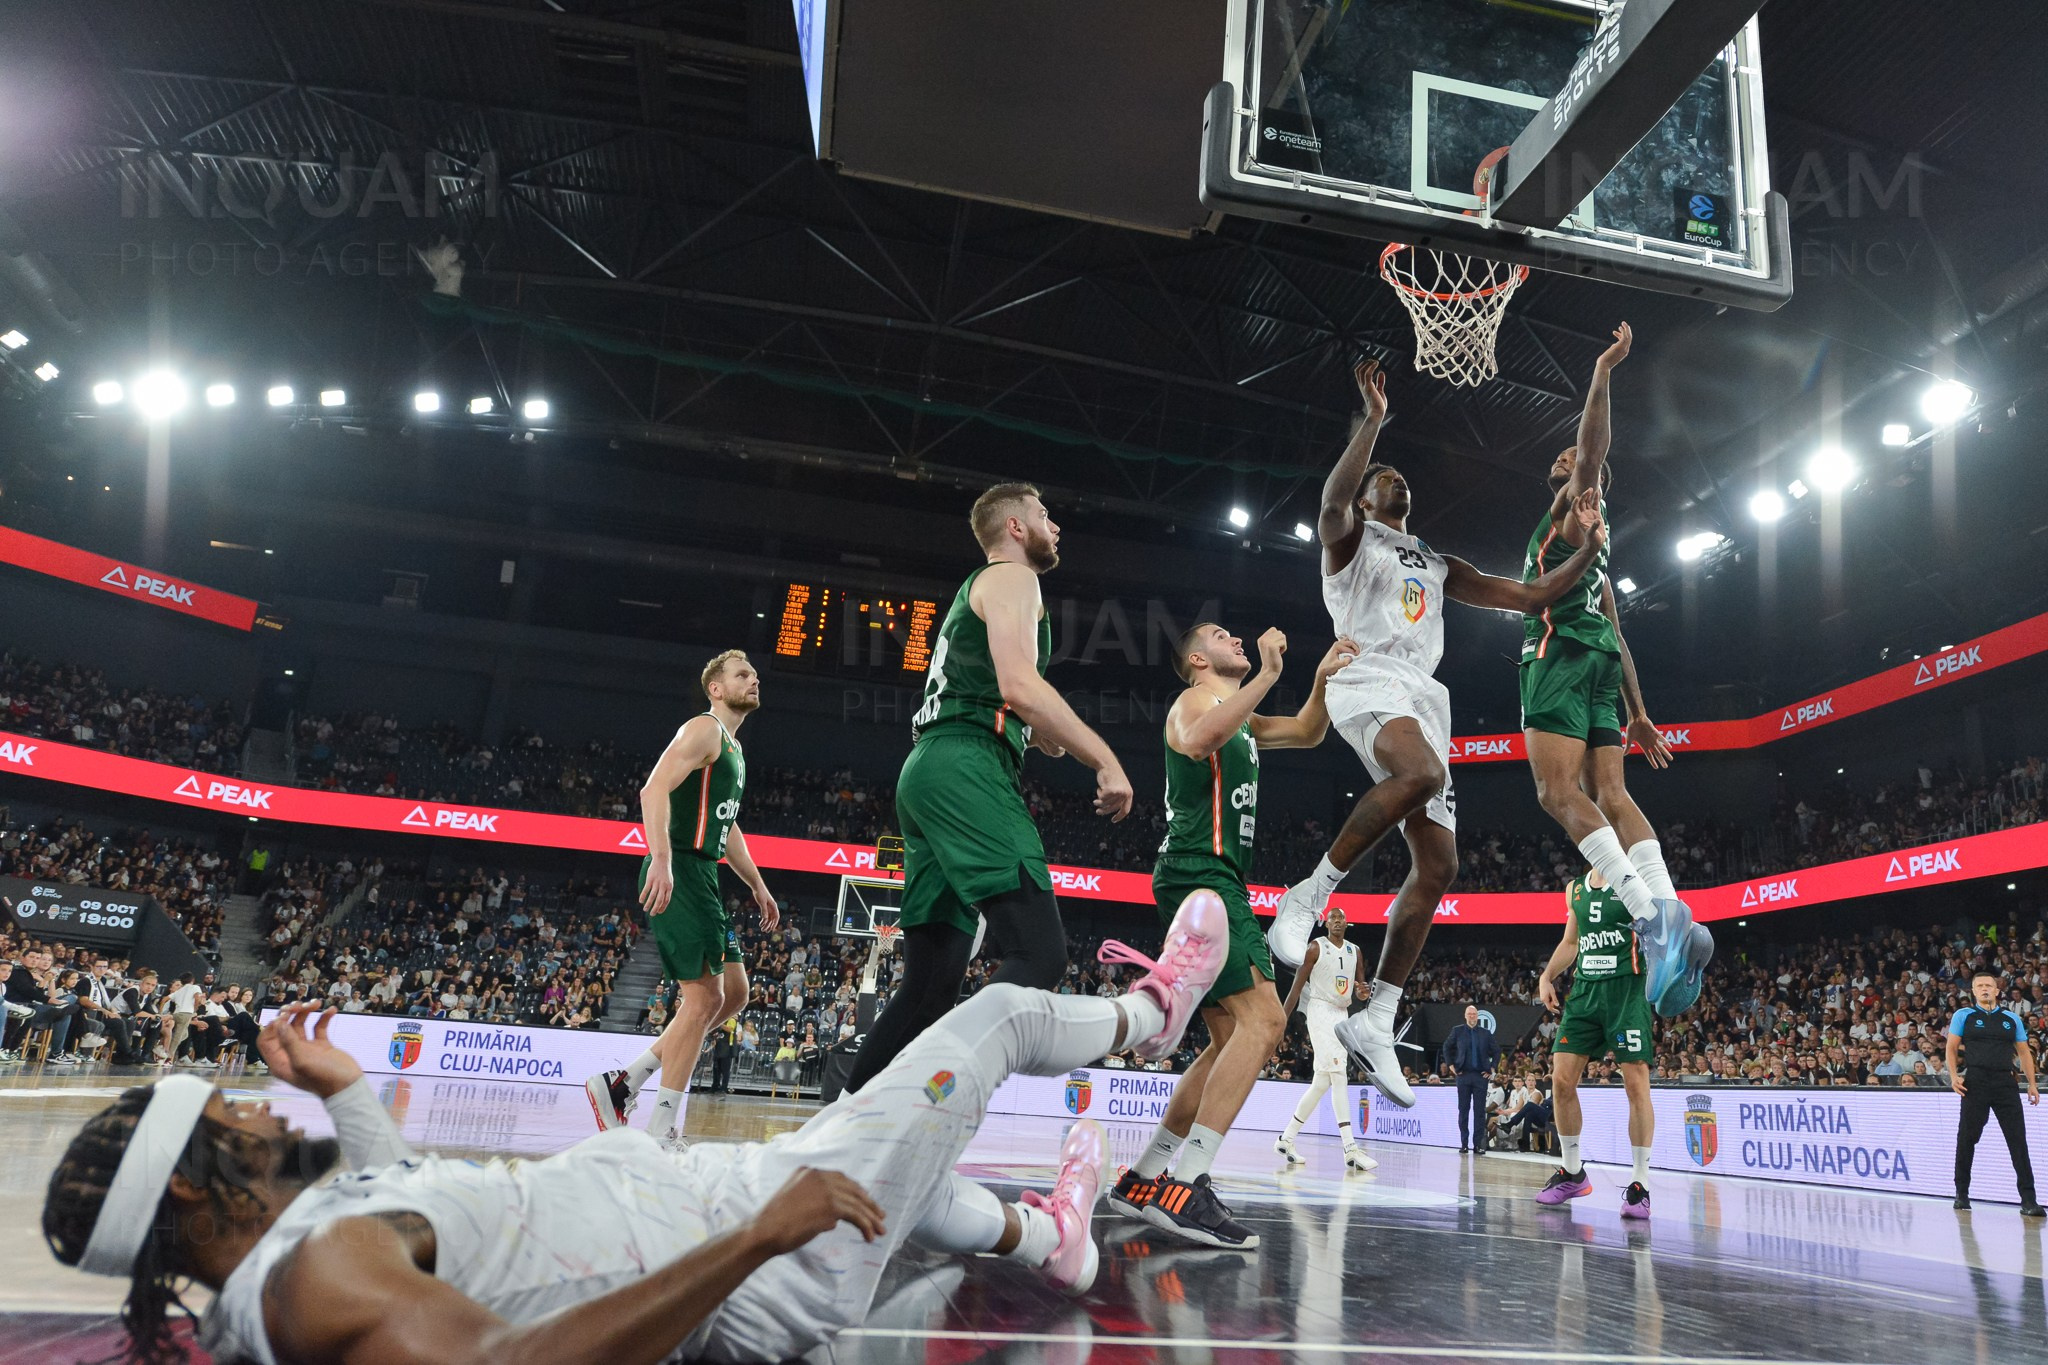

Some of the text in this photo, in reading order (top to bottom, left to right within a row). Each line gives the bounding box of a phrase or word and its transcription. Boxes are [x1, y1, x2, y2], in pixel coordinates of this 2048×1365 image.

[1554, 41, 1620, 130] sports
[1279, 135, 1321, 149] oneteam
[1684, 232, 1722, 247] EuroCup
[1395, 546, 1427, 570] 23
[134, 575, 195, 606] PEAK
[1935, 645, 1982, 677] PEAK
[1797, 697, 1834, 724] PEAK
[1465, 739, 1512, 756] PEAK
[207, 782, 274, 809] PEAK
[435, 810, 499, 833] PEAK
[1909, 848, 1962, 878] PEAK
[1050, 871, 1101, 892] PEAK
[1759, 879, 1799, 904] PEAK
[80, 900, 138, 915] 09 OCT
[1248, 890, 1282, 909] EAK
[1434, 900, 1459, 916] AK
[79, 912, 134, 929] 19:00
[1588, 901, 1603, 923] 5
[1338, 956, 1344, 970] 1
[1337, 979, 1346, 988] BT
[443, 1029, 532, 1053] PRIMĂRIA
[1625, 1029, 1642, 1052] 5
[440, 1053, 563, 1078] CLUJ-NAPOCA
[1109, 1076, 1174, 1097] PRIMĂRI
[1375, 1117, 1422, 1138] CLUJ-NAPOCA
[1739, 1097, 1853, 1135] PRIMĂRIA
[1742, 1140, 1911, 1182] CLUJ-NAPOCA
